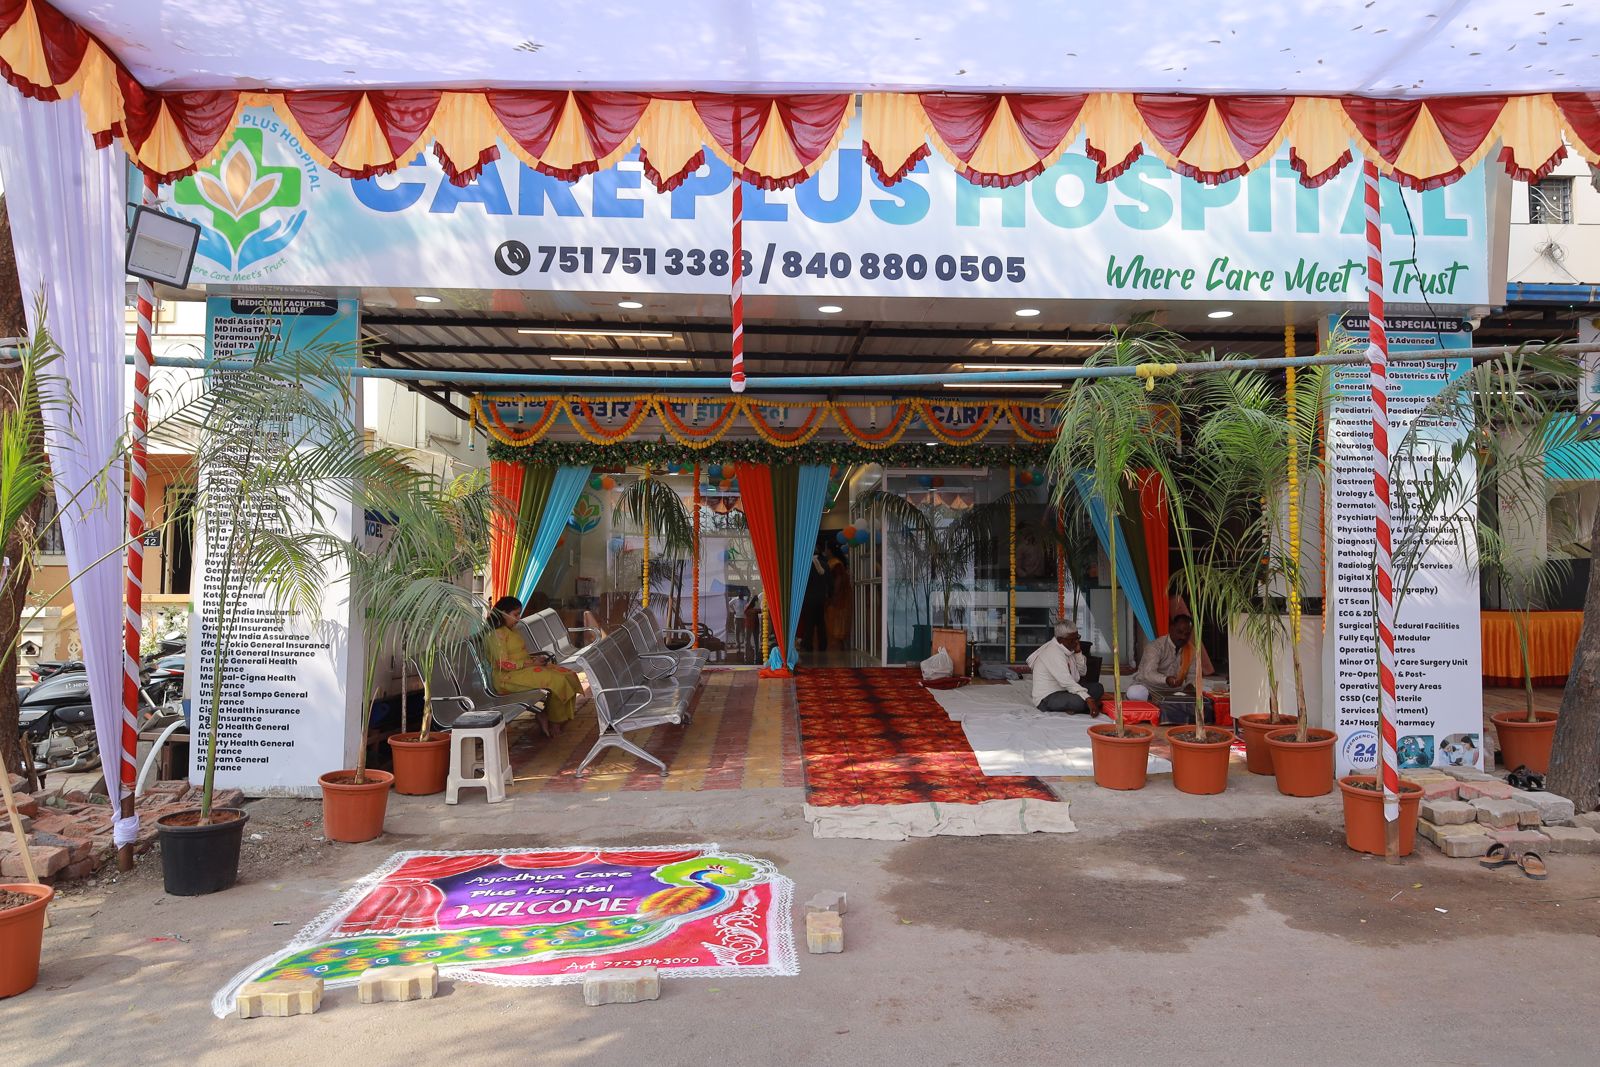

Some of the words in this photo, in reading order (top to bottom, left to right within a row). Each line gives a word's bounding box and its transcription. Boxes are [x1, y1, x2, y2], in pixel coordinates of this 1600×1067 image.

[242, 114, 279, 133] PLUS
[280, 129, 321, 192] HOSPITAL
[350, 140, 645, 219] CARE
[671, 144, 931, 226] PLUS
[956, 151, 1468, 237] HOSPITAL
[538, 246, 594, 274] 751
[601, 247, 656, 275] 751
[758, 243, 777, 284] /
[781, 251, 852, 279] 840
[859, 253, 928, 280] 880
[934, 254, 1026, 283] 0505
[192, 264, 208, 277] ere
[210, 271, 230, 281] Care
[1106, 255, 1195, 291] Where
[1205, 256, 1275, 291] Care
[1389, 258, 1469, 295] Trust
[1347, 320, 1394, 329] CLINAL
[1395, 320, 1458, 330] SPECIALTIES
[1427, 362, 1457, 370] Surgery
[1339, 623, 1372, 631] Surgical
[200, 674, 265, 683] Mapal-Cigna
[242, 691, 272, 699] Sompo
[199, 707, 224, 715] Ciga
[1396, 720, 1435, 728] harmacy
[198, 739, 228, 748] Librty
[1354, 743, 1376, 756] 24
[465, 872, 566, 886] Ayodhya
[575, 871, 633, 879] Care
[469, 888, 517, 898] Plus
[455, 897, 635, 920] WELCOME
